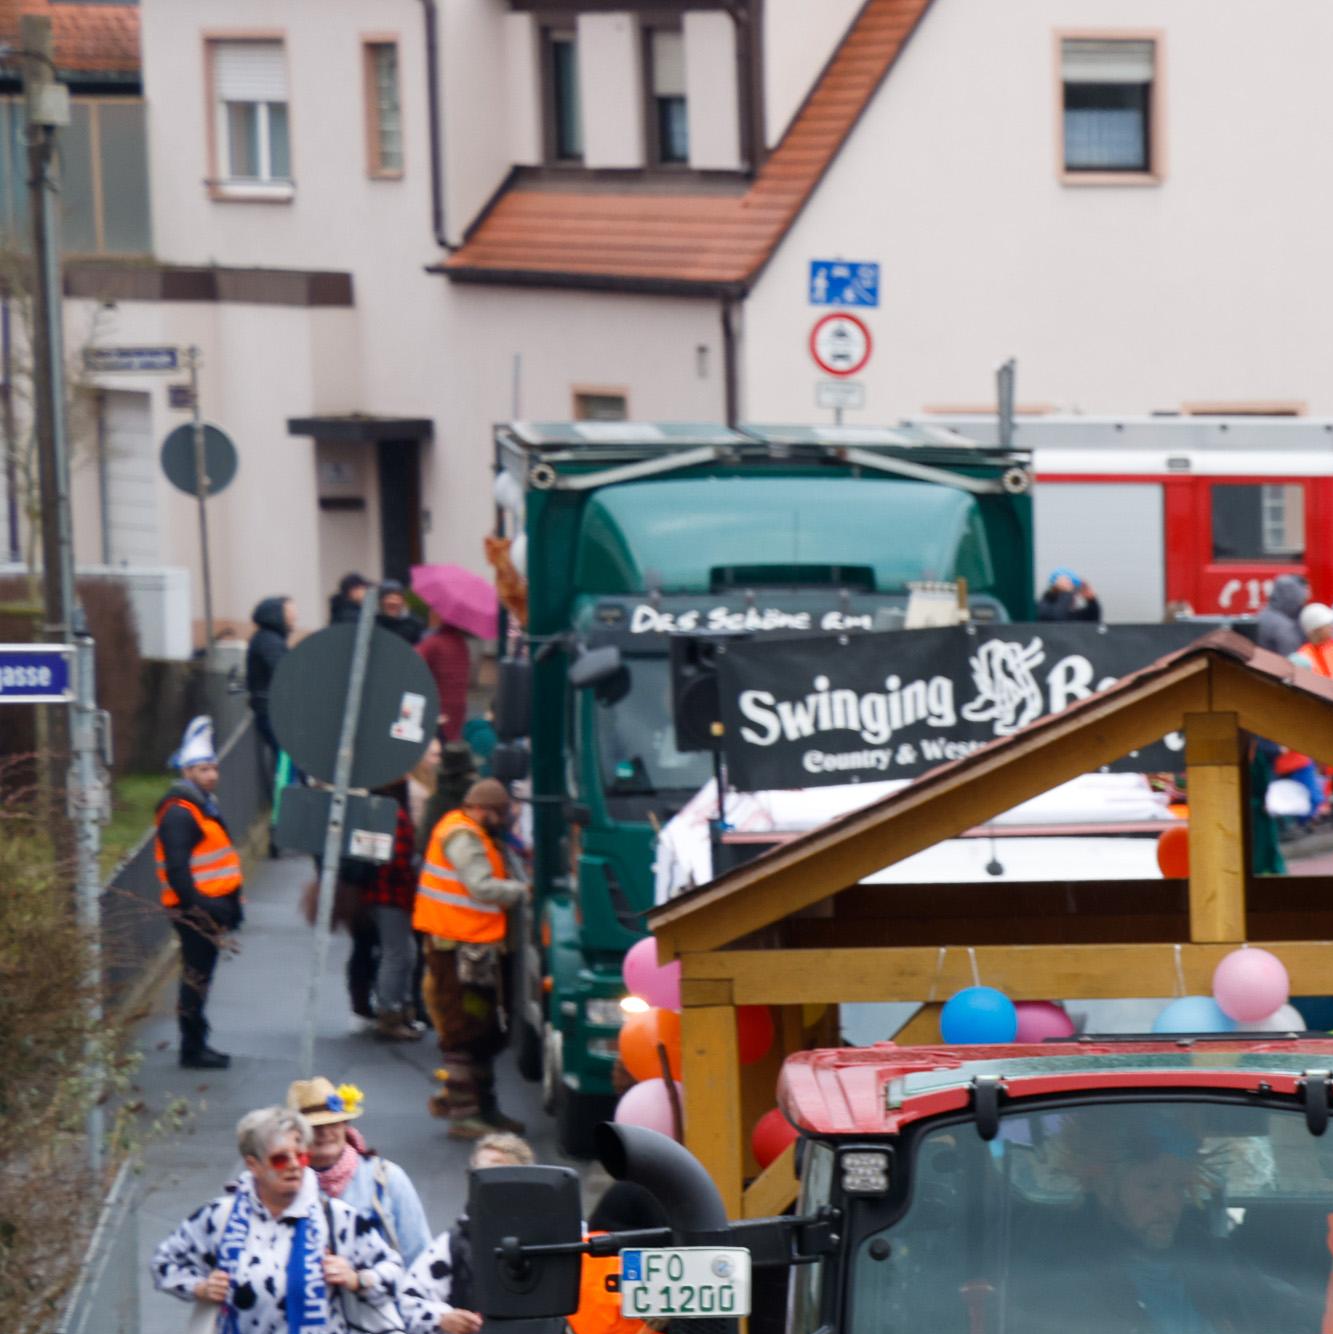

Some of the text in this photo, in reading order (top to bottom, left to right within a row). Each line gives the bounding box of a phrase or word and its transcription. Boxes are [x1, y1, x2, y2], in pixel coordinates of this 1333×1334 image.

[739, 675, 958, 746] Swinging
[803, 750, 891, 773] Country
[895, 743, 917, 765] &
[646, 1253, 684, 1281] FO
[633, 1285, 735, 1313] C 1200
